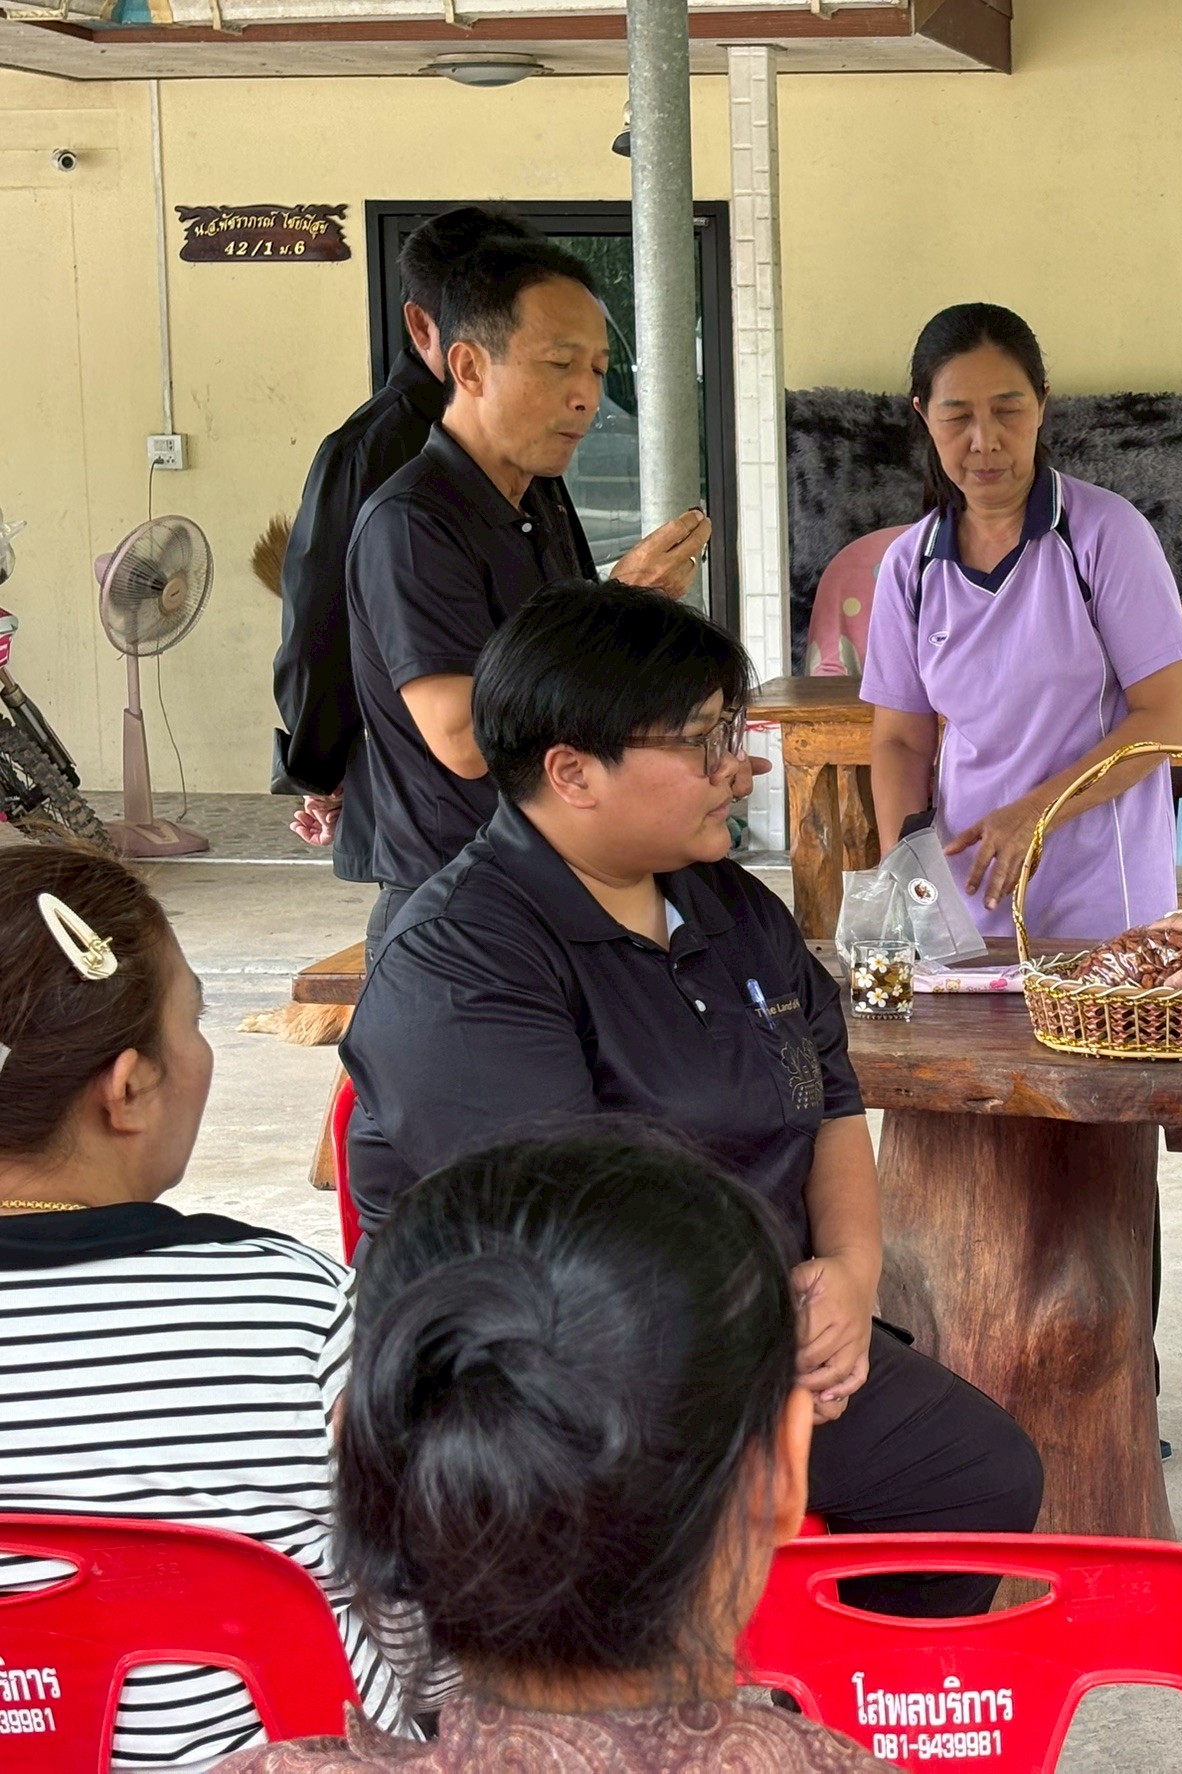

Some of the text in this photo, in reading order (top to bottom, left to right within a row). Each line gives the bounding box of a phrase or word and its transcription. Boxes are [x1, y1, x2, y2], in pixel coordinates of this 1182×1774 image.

[224, 240, 273, 257] 42/1
[851, 1671, 1014, 1727] โสพลบริการ
[872, 1729, 1002, 1760] 081-9439981
